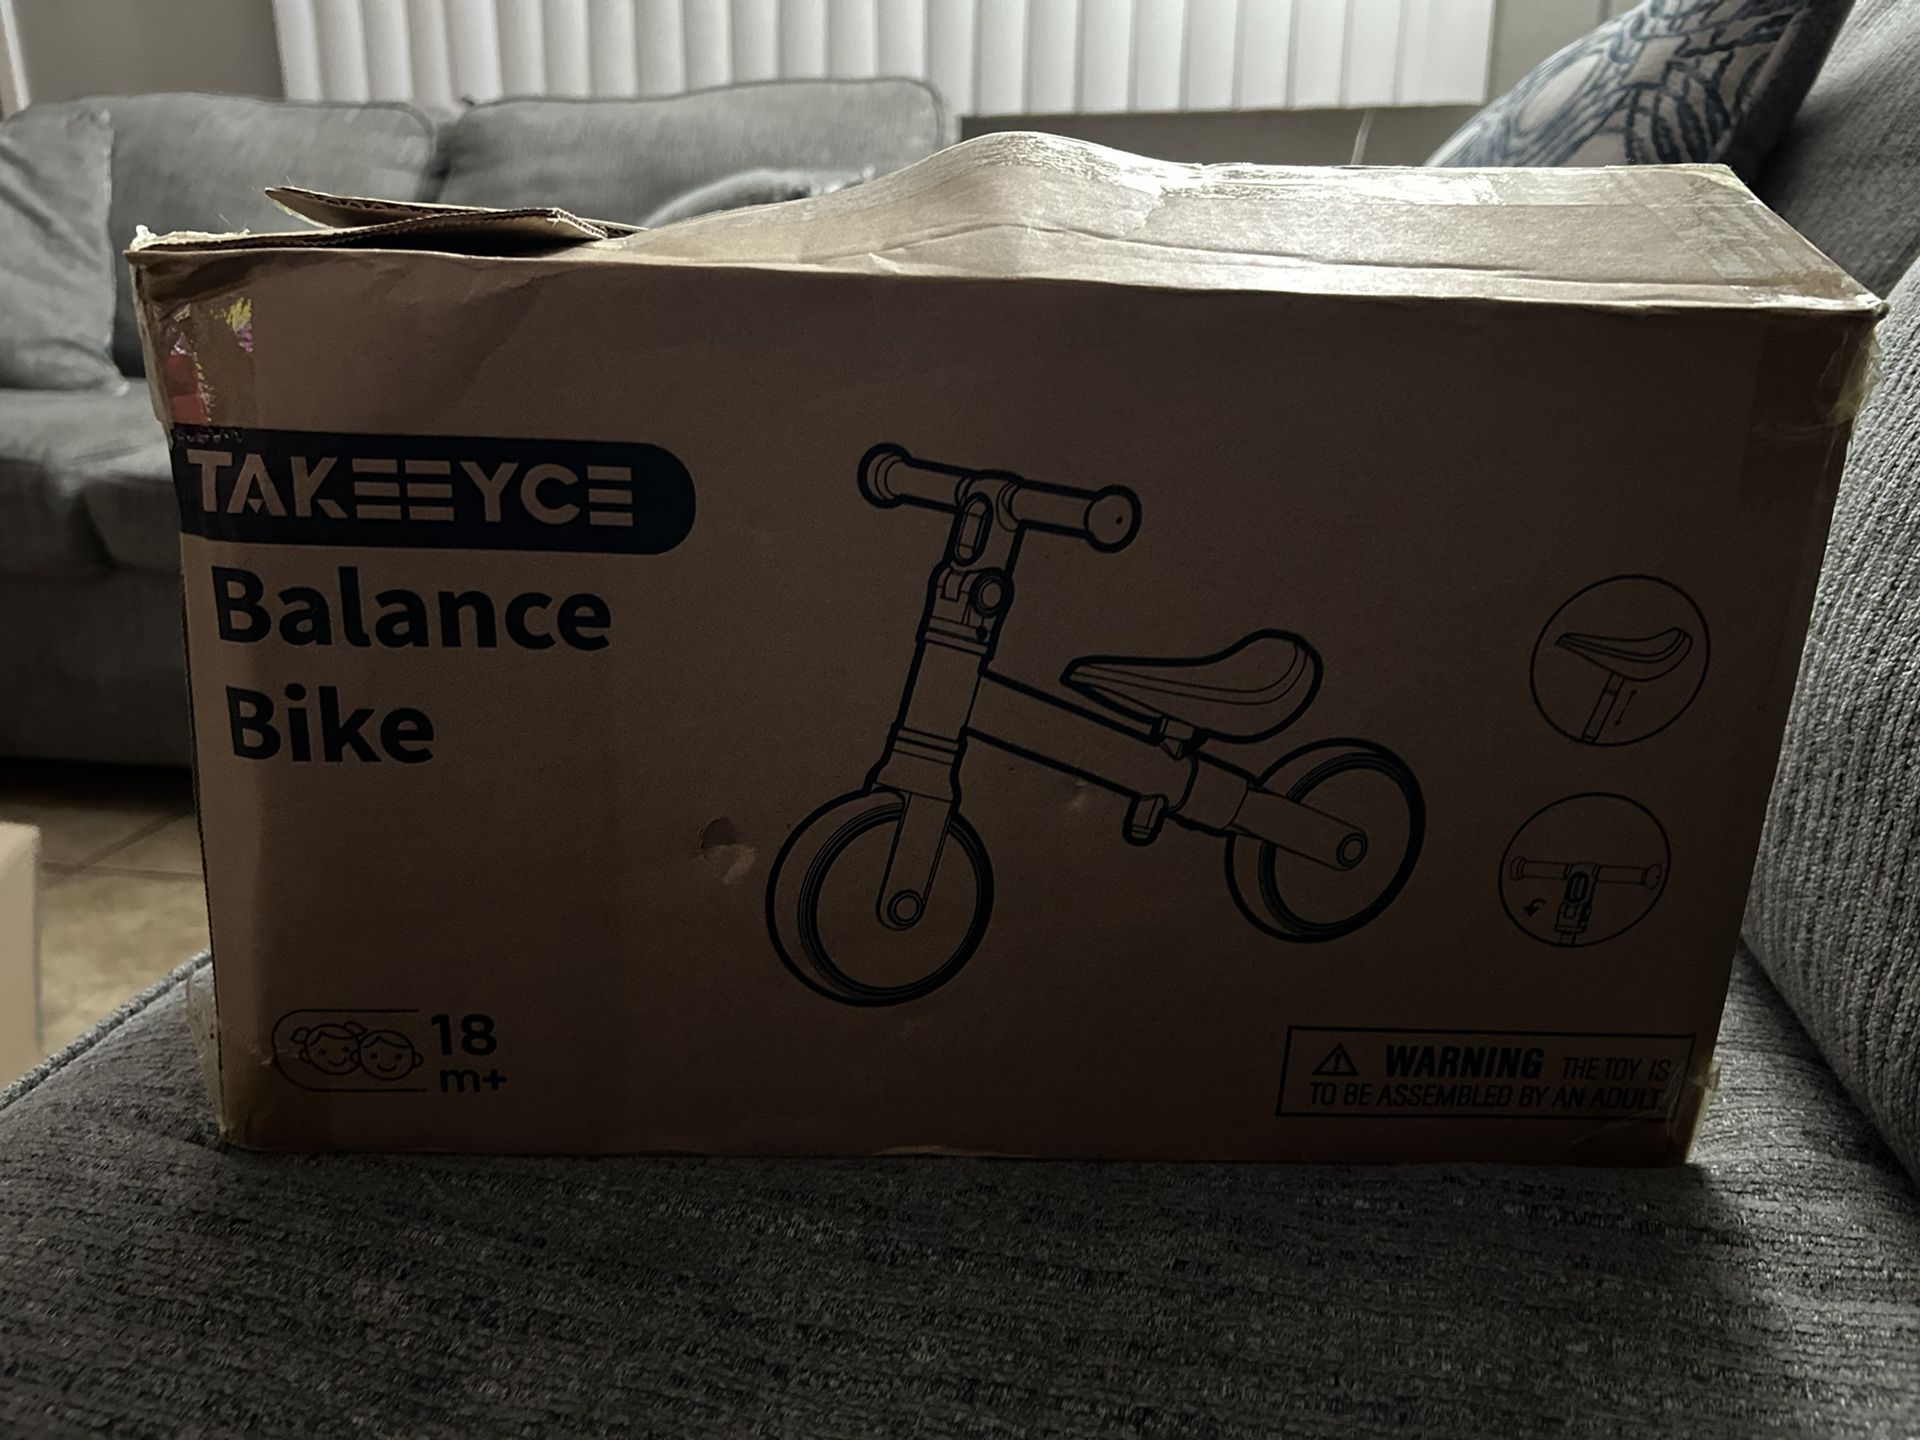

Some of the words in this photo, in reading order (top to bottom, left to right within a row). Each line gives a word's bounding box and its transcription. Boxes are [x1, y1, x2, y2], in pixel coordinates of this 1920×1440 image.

[186, 449, 635, 528] TAKEEYCE
[211, 565, 612, 651] Balance
[226, 683, 435, 763] Bike
[431, 1014, 498, 1056] 18
[439, 1069, 508, 1092] m+
[1385, 1045, 1545, 1079] WARNING
[1562, 1056, 1602, 1080] THE
[1604, 1058, 1642, 1082] TOY
[1648, 1059, 1671, 1082] IS
[1309, 1082, 1337, 1106] TO
[1343, 1082, 1373, 1107] BE
[1377, 1083, 1513, 1108] ASSEMBLED
[1518, 1085, 1550, 1109] BY
[1551, 1087, 1585, 1109] AN
